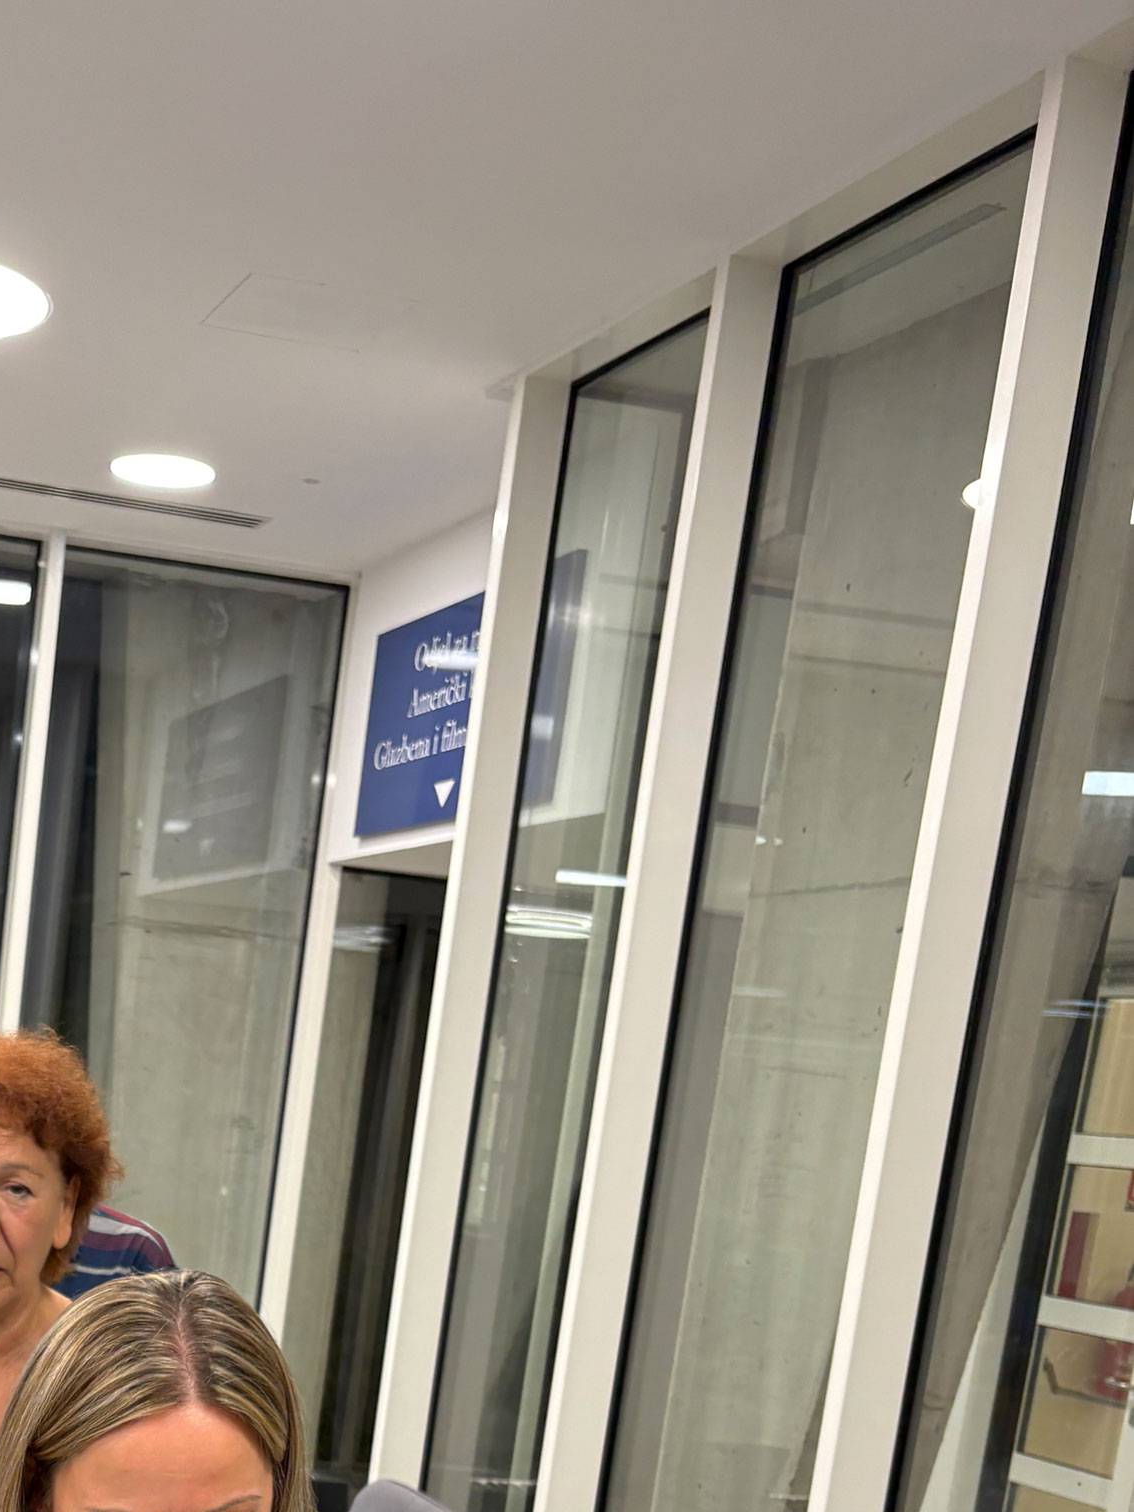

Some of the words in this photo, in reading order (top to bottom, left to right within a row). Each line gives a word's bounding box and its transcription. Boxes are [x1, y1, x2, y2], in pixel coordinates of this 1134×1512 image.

[407, 673, 467, 718] Američki
[373, 733, 431, 771] Glazbena
[432, 725, 441, 755] i
[441, 719, 467, 753] film
